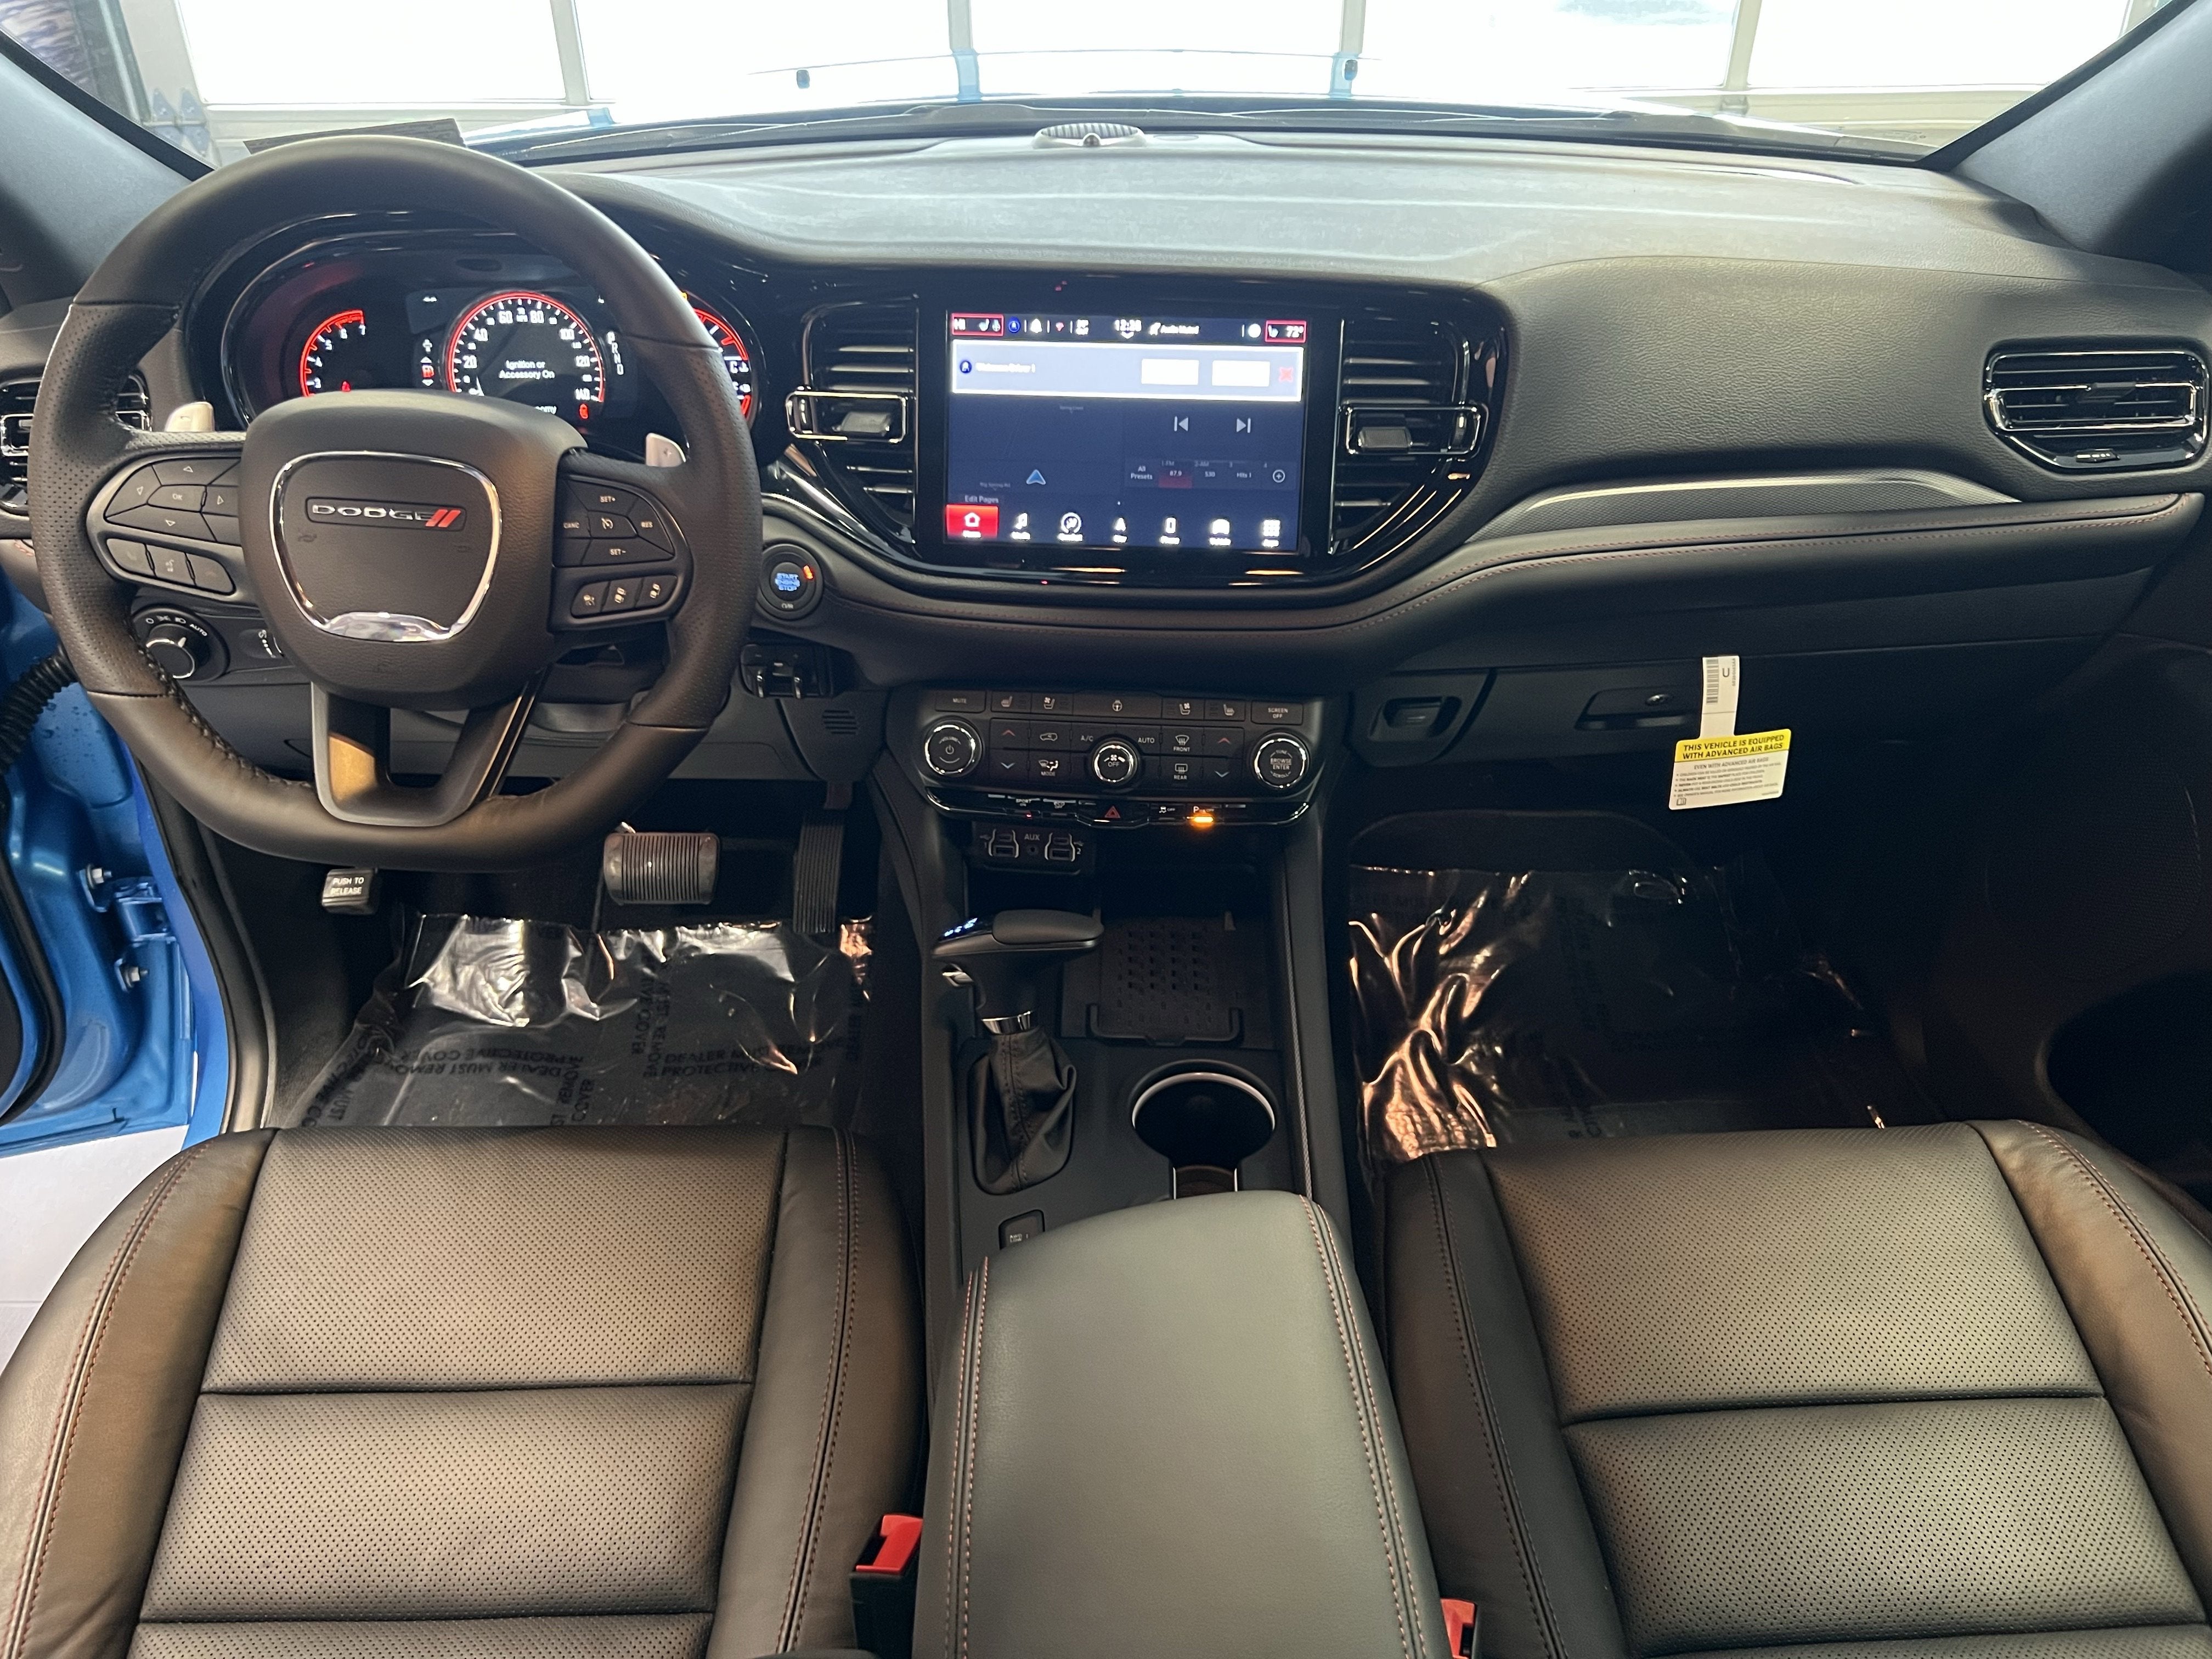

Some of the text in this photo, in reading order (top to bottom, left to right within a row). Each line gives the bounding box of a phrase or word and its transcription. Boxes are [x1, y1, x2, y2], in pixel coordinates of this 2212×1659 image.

[499, 311, 513, 324] 60
[530, 310, 544, 323] 80
[473, 328, 488, 341] 40
[559, 328, 575, 340] 100
[606, 331, 616, 344] P
[325, 338, 333, 351] 5
[462, 355, 477, 368] 20
[575, 355, 590, 368] 120
[499, 369, 555, 379] Accessory On
[575, 388, 590, 400] 140
[964, 495, 998, 504] Edit Pages
[312, 504, 435, 521] DODGE
[189, 624, 207, 636] AUTO
[1722, 667, 1730, 678] U
[1704, 741, 1737, 750] VEHICLE
[1748, 735, 1785, 744] EQUIPPED
[1705, 748, 1748, 758] ADVANCED
[1764, 742, 1783, 751] BAGS
[330, 887, 362, 895] RELEASE
